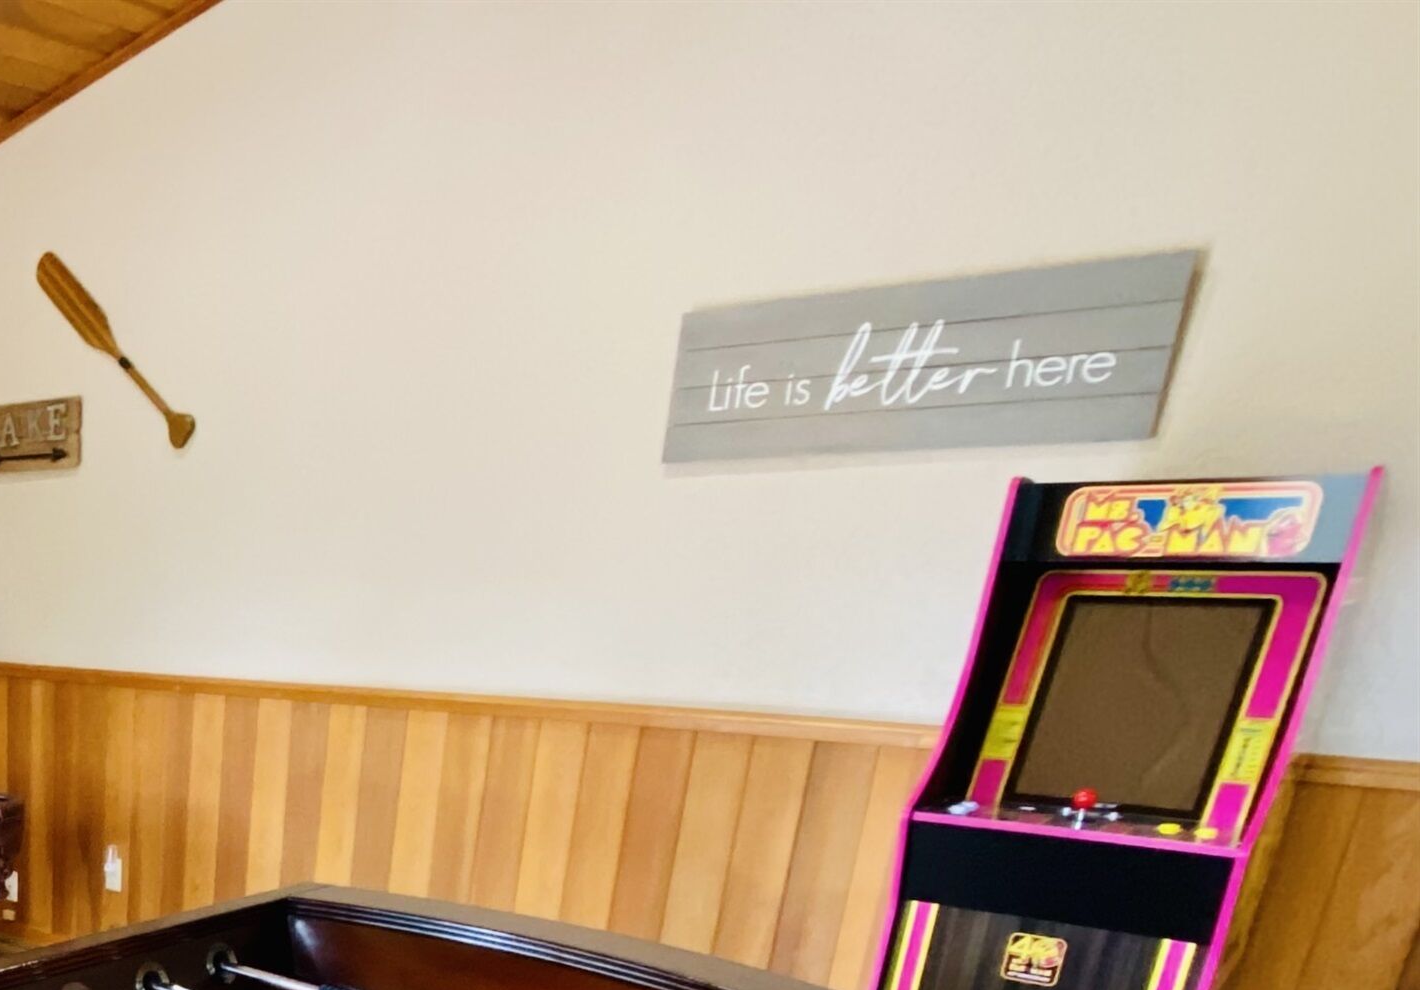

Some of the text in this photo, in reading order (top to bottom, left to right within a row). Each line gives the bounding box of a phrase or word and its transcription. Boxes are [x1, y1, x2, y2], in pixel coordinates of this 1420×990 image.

[707, 318, 1118, 411] Life is better here
